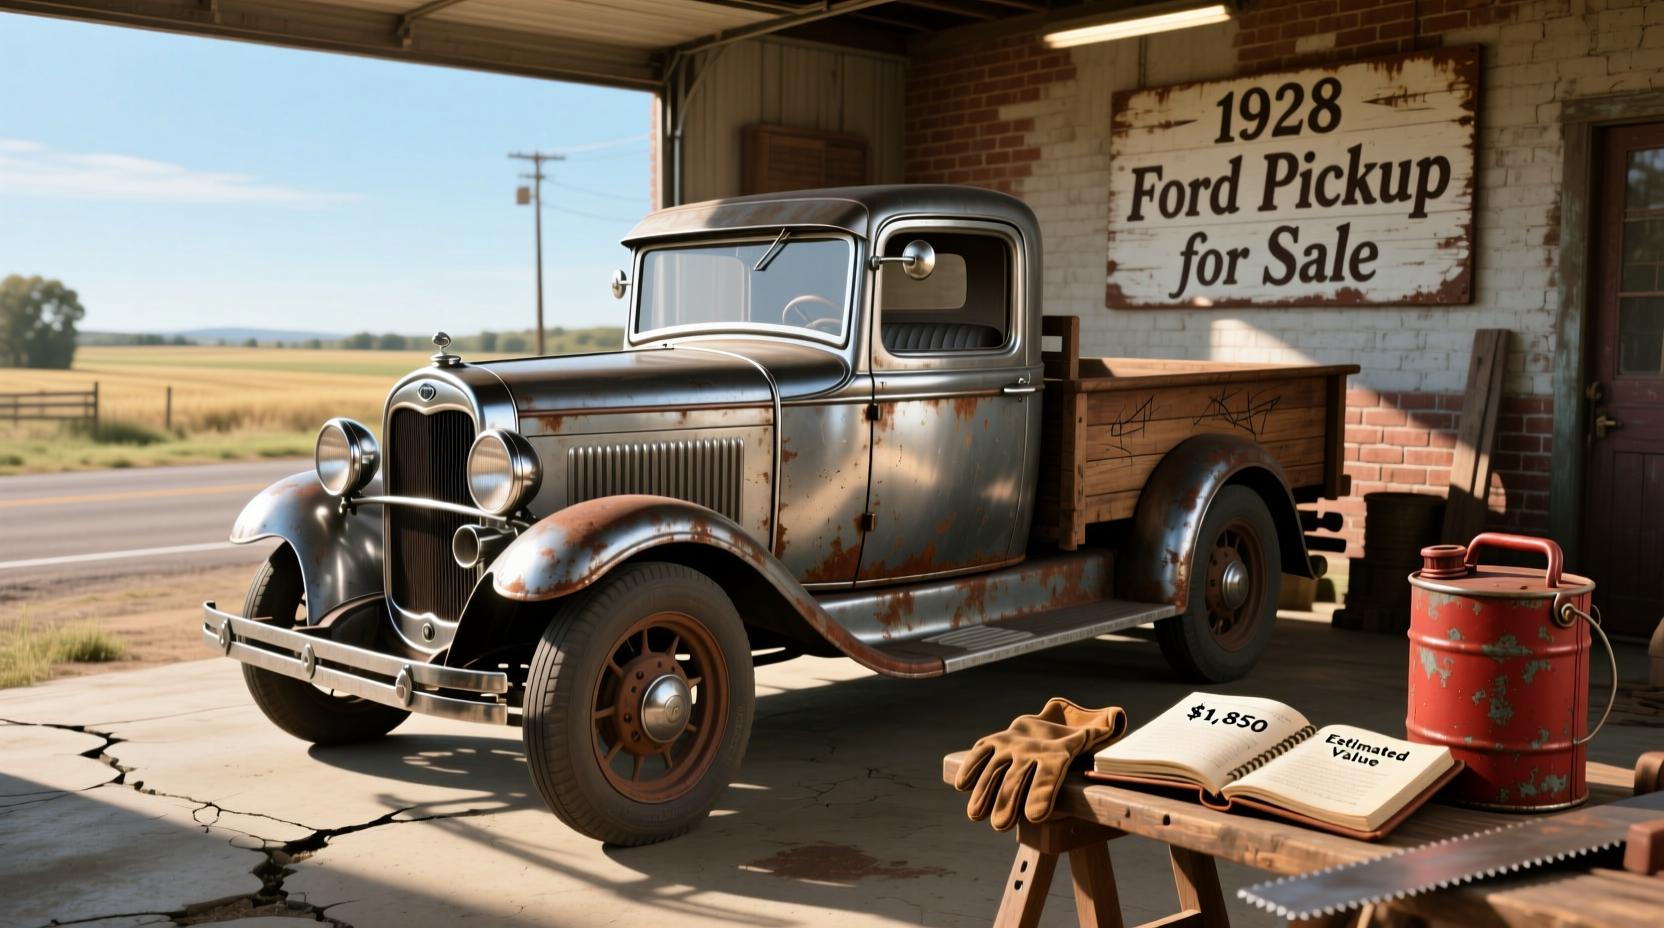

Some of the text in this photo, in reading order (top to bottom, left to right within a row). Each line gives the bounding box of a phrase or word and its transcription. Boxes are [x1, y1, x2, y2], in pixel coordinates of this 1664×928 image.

[1214, 77, 1342, 143] 1928
[1126, 142, 1451, 222] Ford Pickup
[1168, 222, 1379, 299] for Sale
[1187, 703, 1268, 733] $1,850
[1325, 733, 1410, 762] Estimated
[1332, 746, 1379, 767] Value
